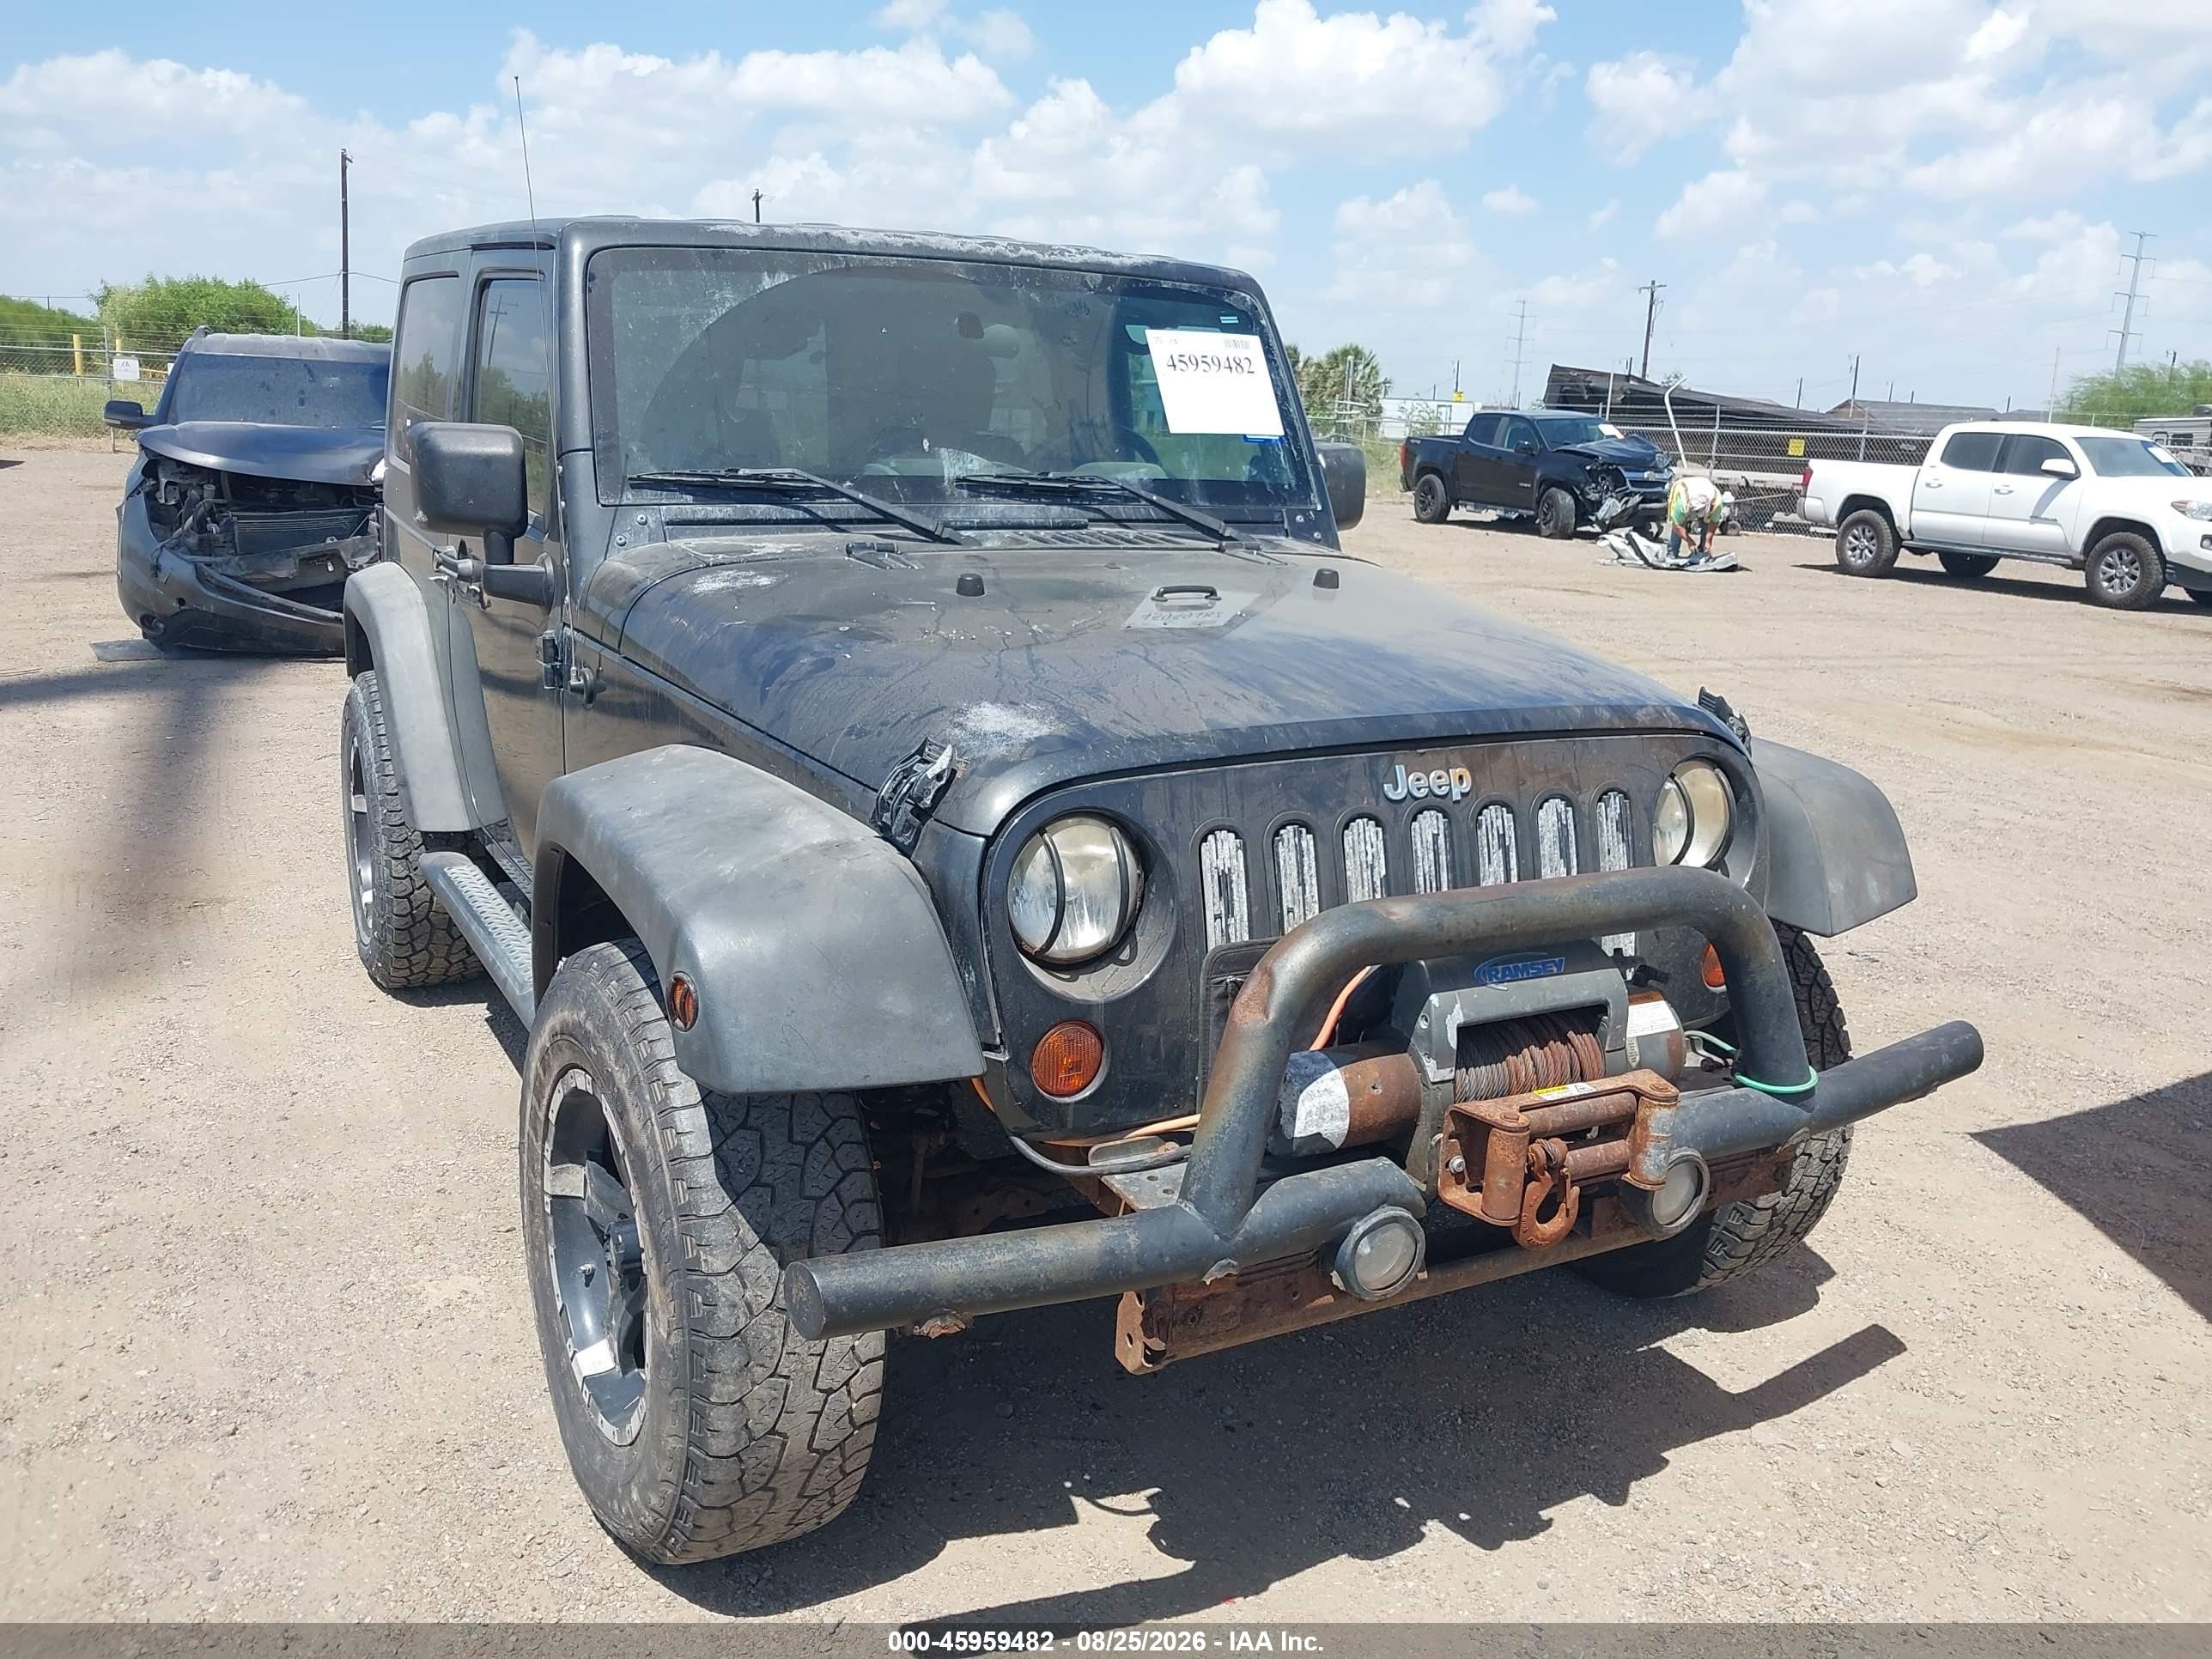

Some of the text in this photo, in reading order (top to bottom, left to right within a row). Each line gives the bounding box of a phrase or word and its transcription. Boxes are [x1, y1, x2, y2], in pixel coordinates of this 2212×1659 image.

[1167, 355, 1255, 374] 45959482
[1382, 764, 1472, 802] Jeep
[1486, 958, 1565, 982] RAMSEY
